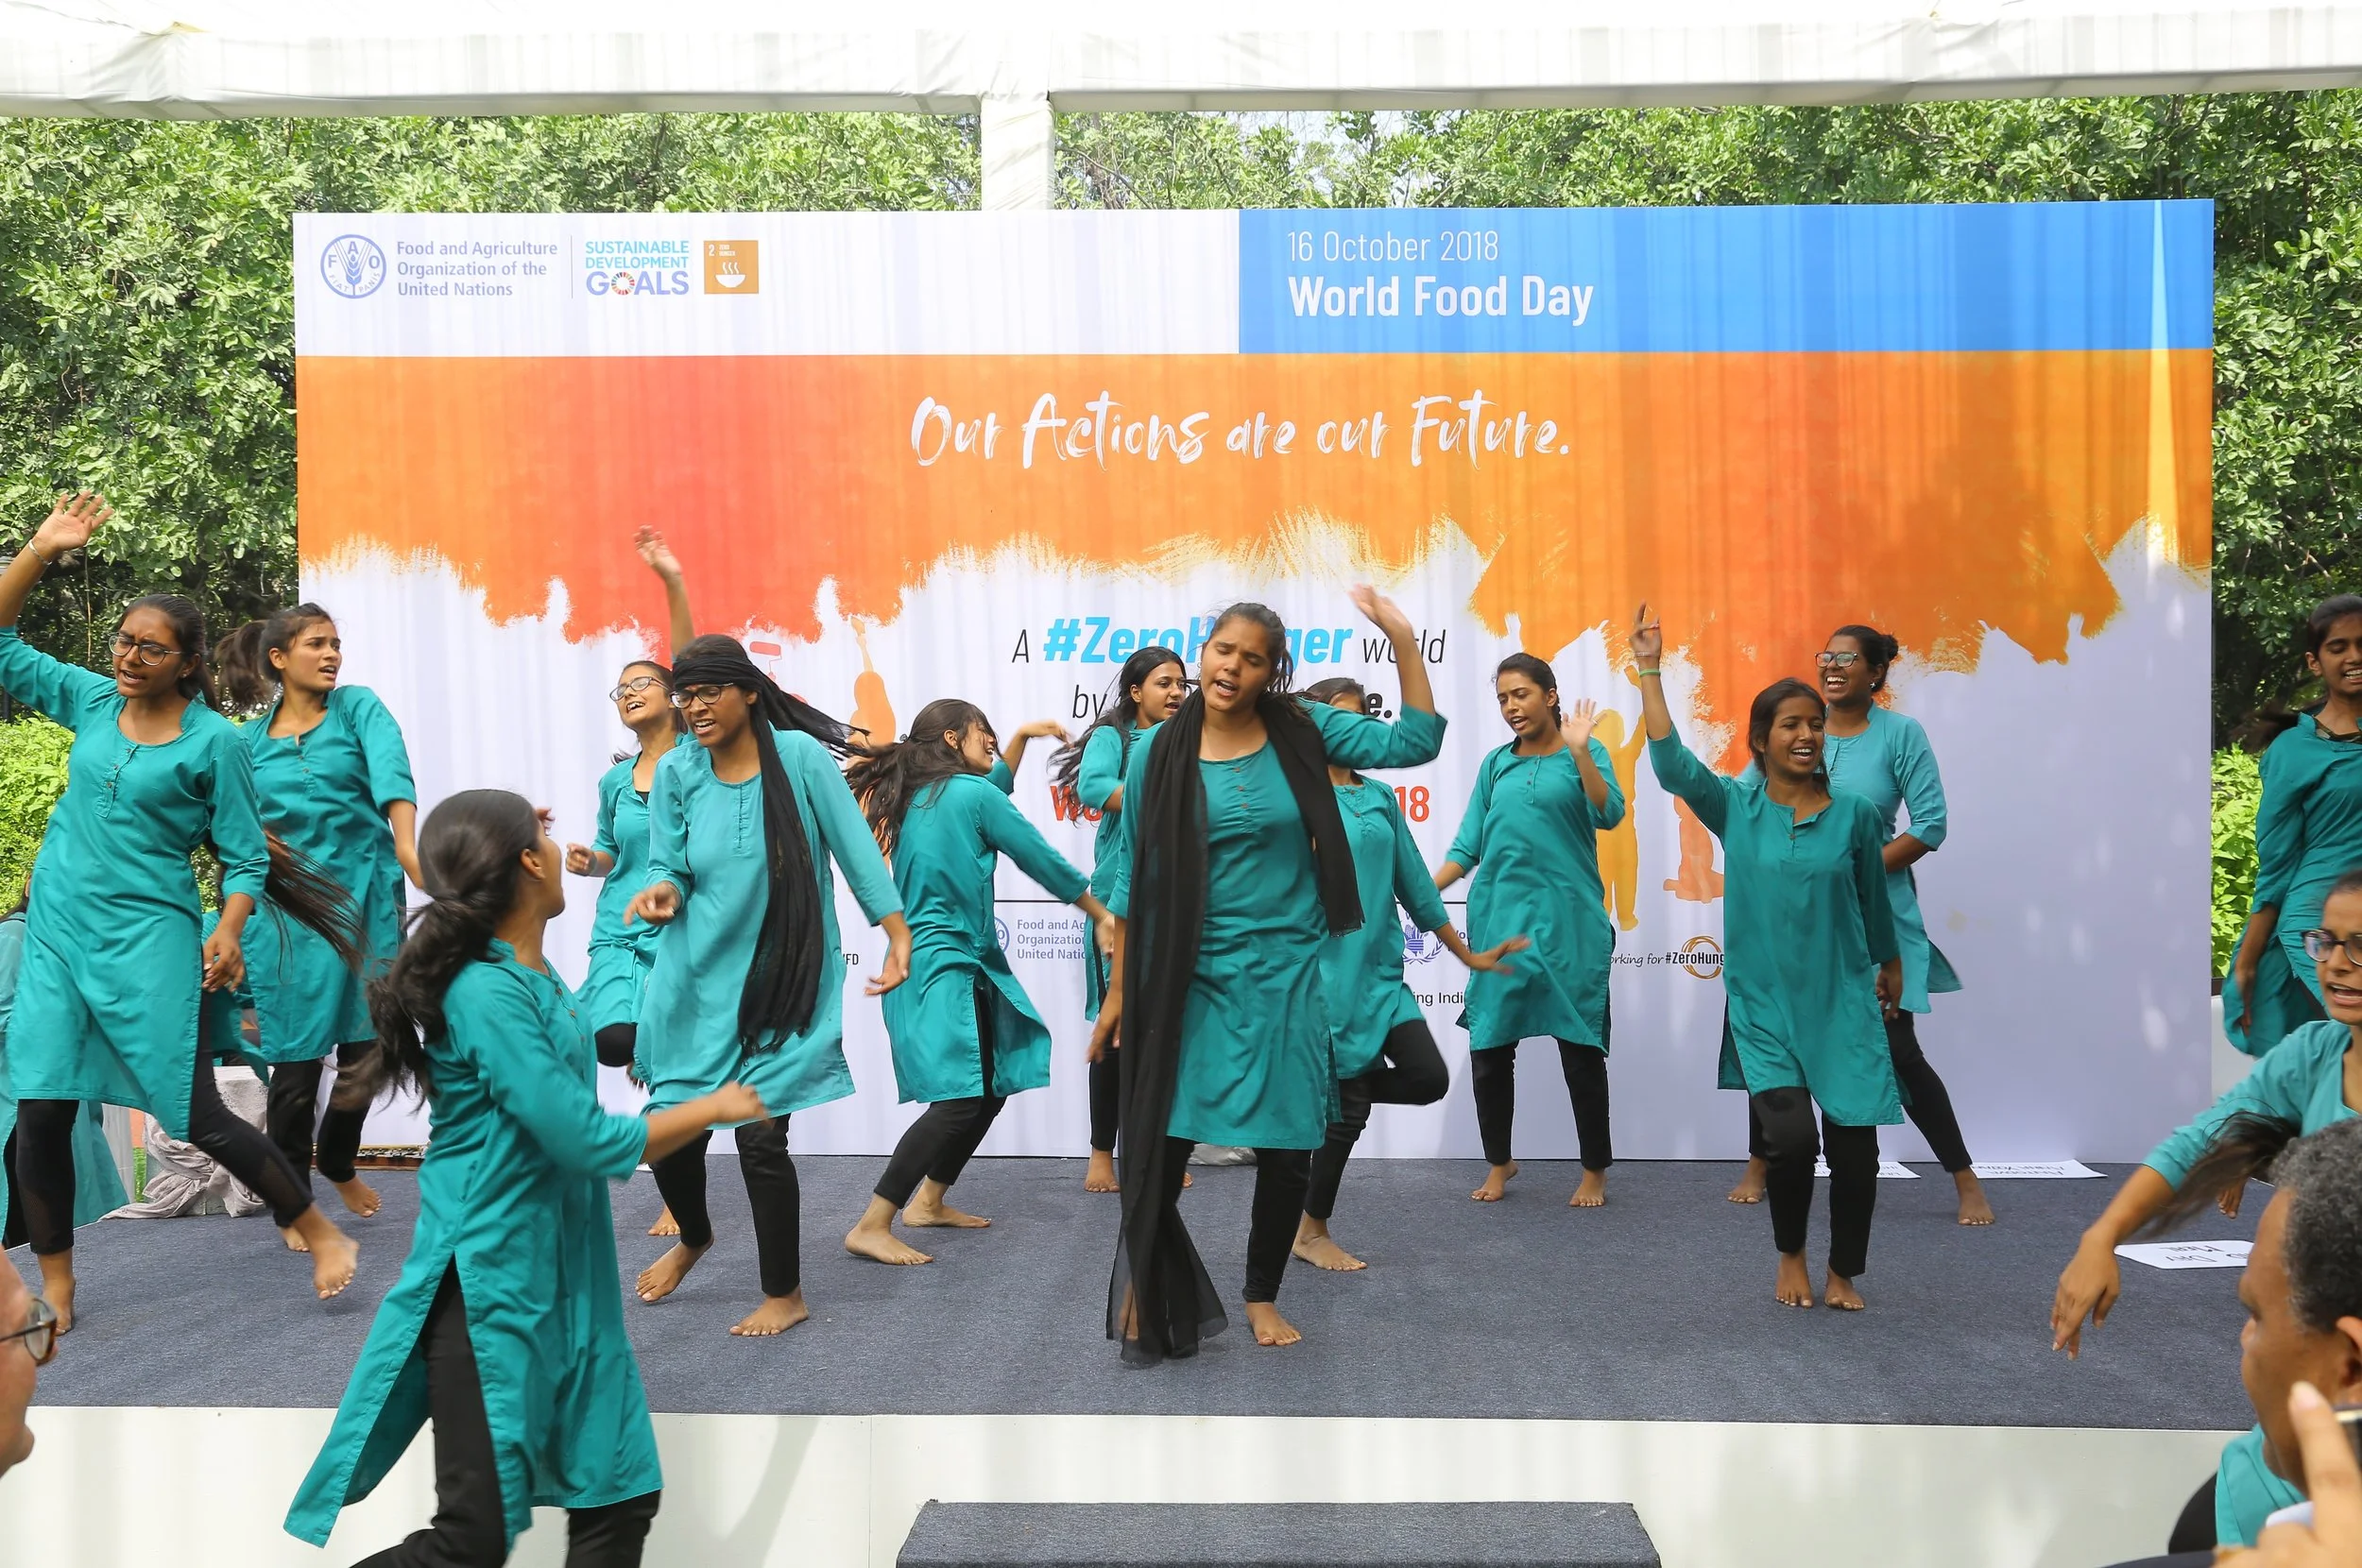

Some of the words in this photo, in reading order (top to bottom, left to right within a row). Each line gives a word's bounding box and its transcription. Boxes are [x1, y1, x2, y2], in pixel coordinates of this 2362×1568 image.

[397, 241, 434, 255] Food
[439, 241, 468, 255] and
[471, 241, 558, 258] Agriculture
[586, 241, 690, 253] SUSTAINABLE
[709, 244, 715, 256] 2
[1288, 231, 1312, 262] 16
[1324, 231, 1430, 262] October
[1440, 231, 1498, 262] 2018
[398, 261, 496, 280] Organization
[502, 261, 517, 276] of
[522, 261, 547, 276] the
[586, 257, 689, 268] DEVELOPMENT
[398, 281, 449, 296] United
[454, 281, 513, 296] Nations
[586, 270, 690, 296] GOALS
[1288, 275, 1399, 316] World
[1414, 275, 1507, 316] Food
[1522, 275, 1594, 327] Day
[911, 396, 1007, 467] Our
[1021, 390, 1210, 471] Actions
[1226, 412, 1295, 459] are
[1316, 411, 1394, 459] our
[1411, 389, 1569, 470] Future.
[1012, 629, 1030, 663] A
[1363, 629, 1446, 664] wld
[1072, 684, 1108, 723] by
[1017, 919, 1044, 930] Food
[1048, 919, 1069, 930] and
[1017, 948, 1053, 959] United
[1610, 953, 1644, 968] orking
[1647, 953, 1664, 964] for
